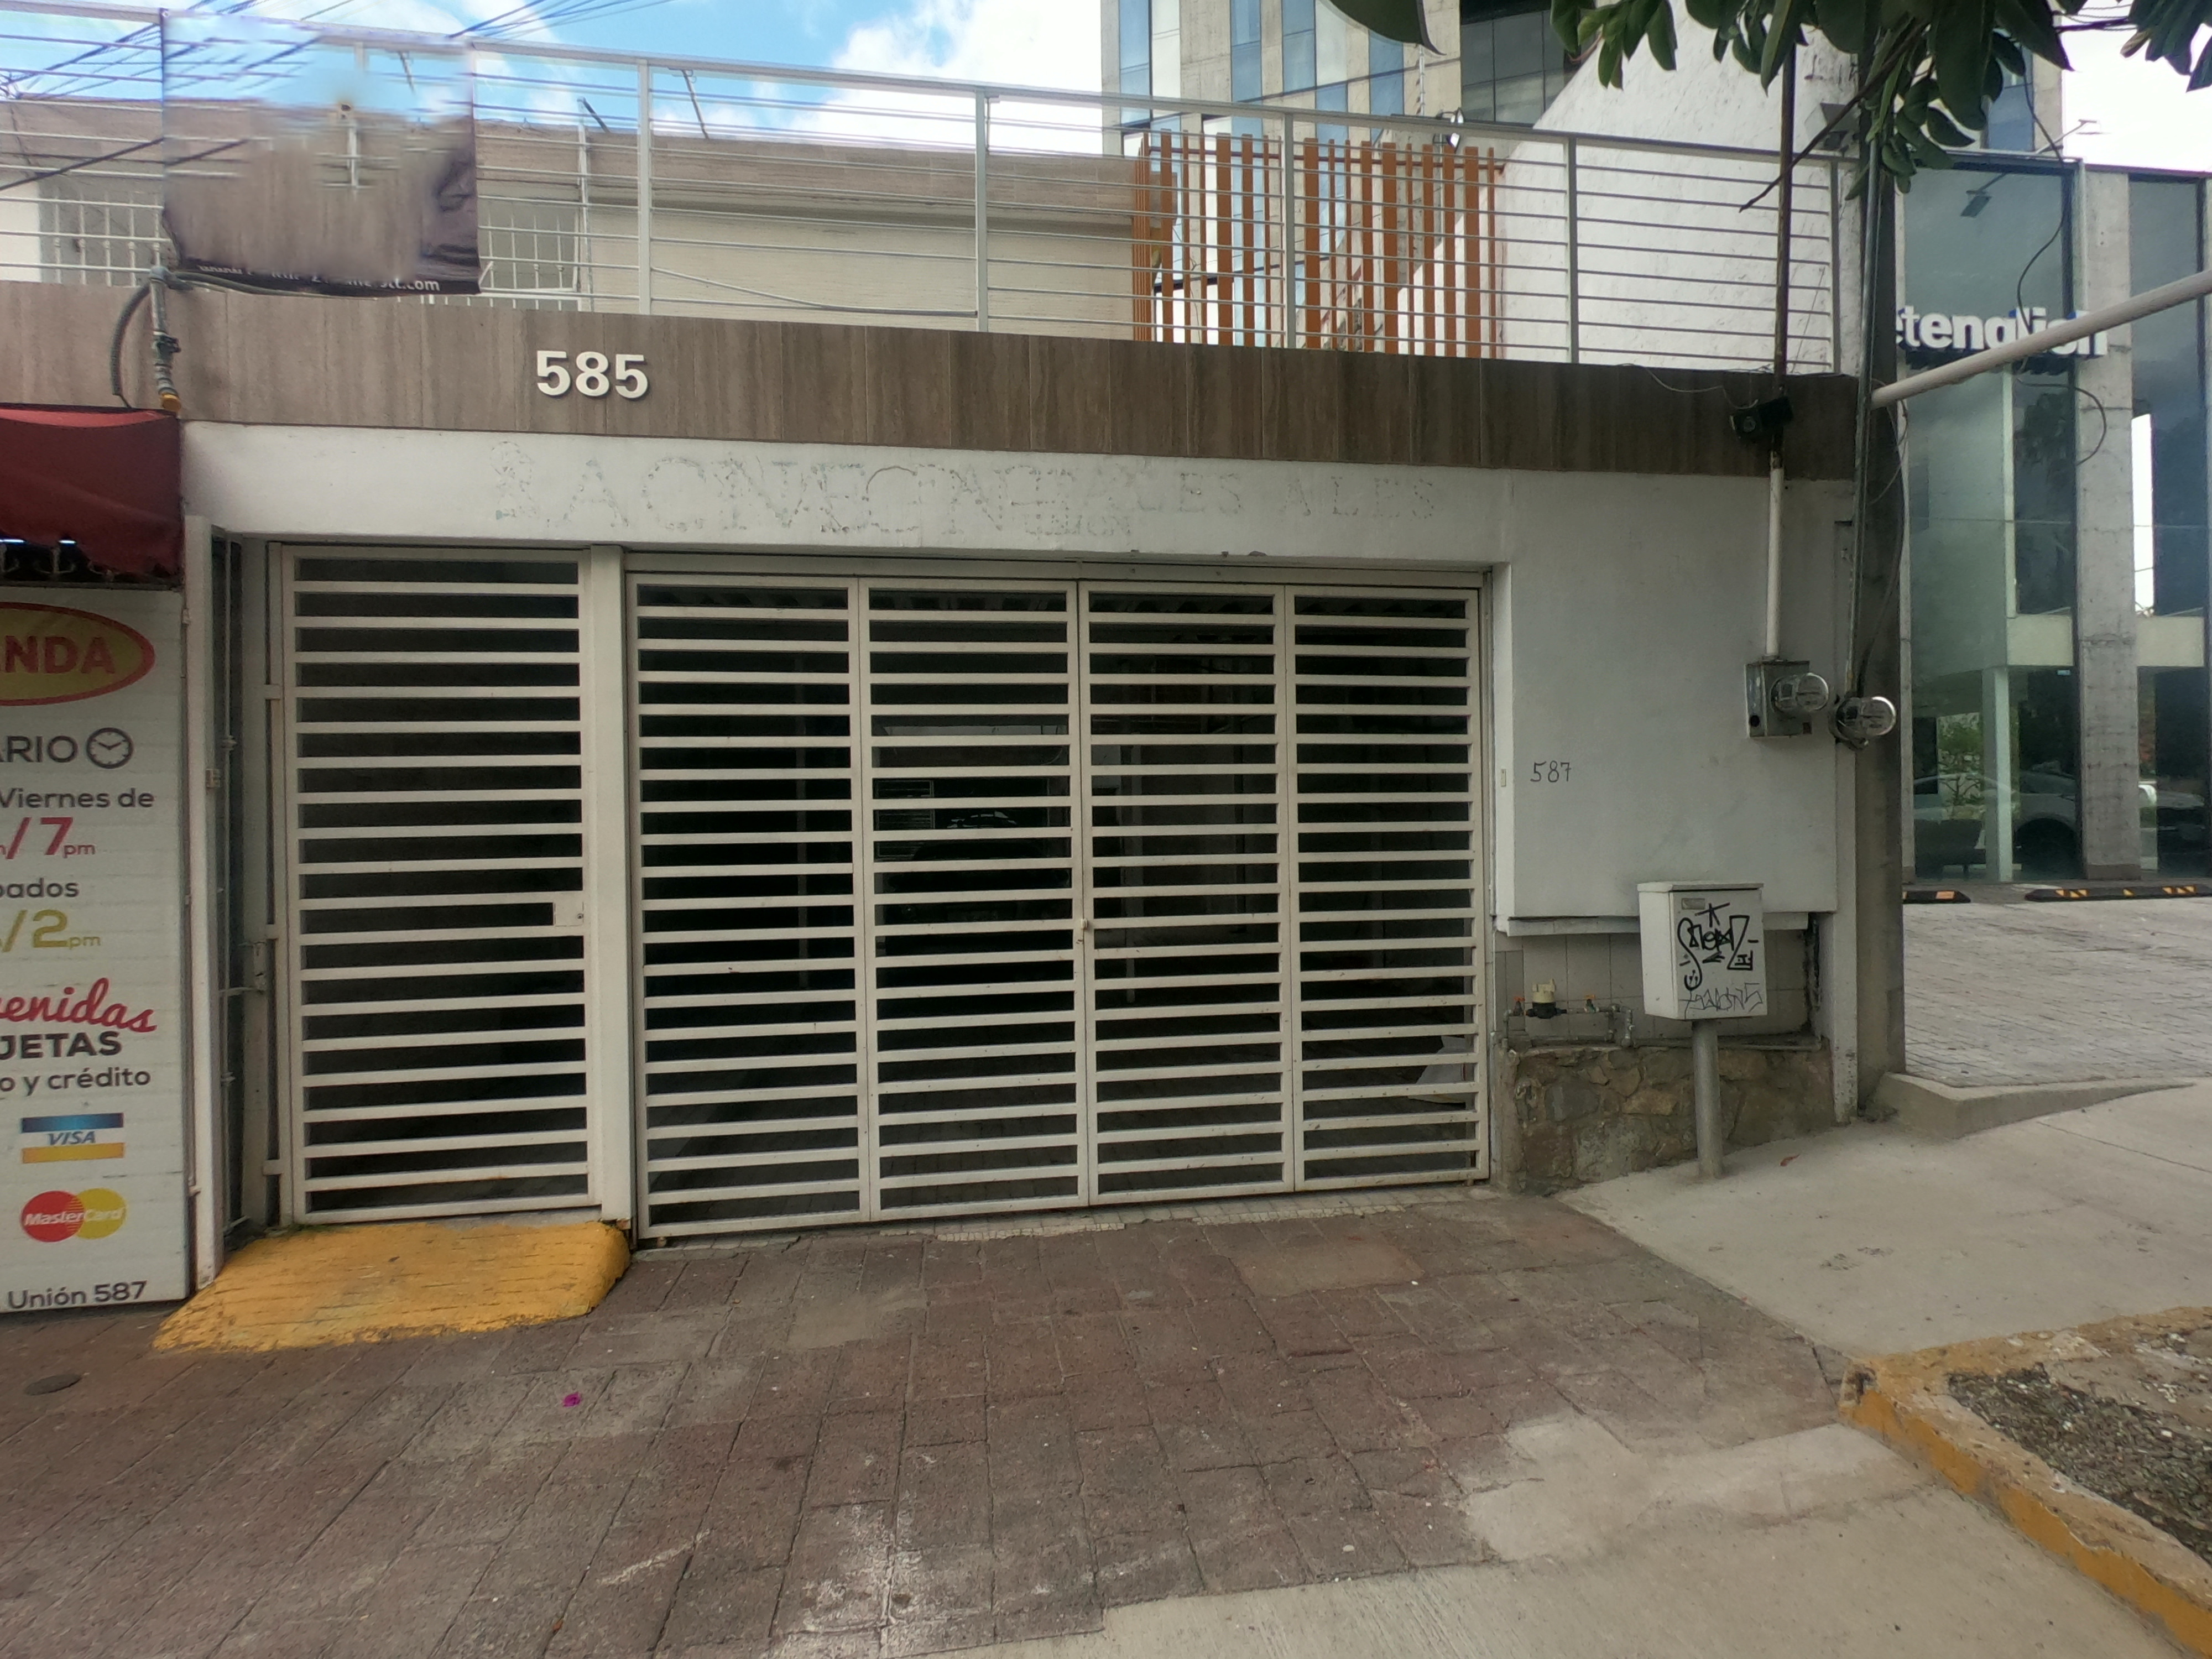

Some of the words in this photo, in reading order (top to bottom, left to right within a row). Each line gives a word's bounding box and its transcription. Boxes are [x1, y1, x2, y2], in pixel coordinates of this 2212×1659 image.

[536, 350, 648, 399] 585
[0, 635, 115, 674] NDA
[0, 735, 78, 763] RIO
[1530, 760, 1572, 783] 587
[0, 787, 110, 808] Viernes
[118, 788, 155, 808] de
[0, 878, 79, 898] ados
[0, 977, 158, 1032] enidas
[0, 1031, 122, 1060] JETAS
[23, 1076, 40, 1097] y
[48, 1067, 151, 1089] crédito
[48, 1131, 96, 1145] VISA
[8, 1287, 86, 1310] Unión
[93, 1280, 148, 1303] 587
